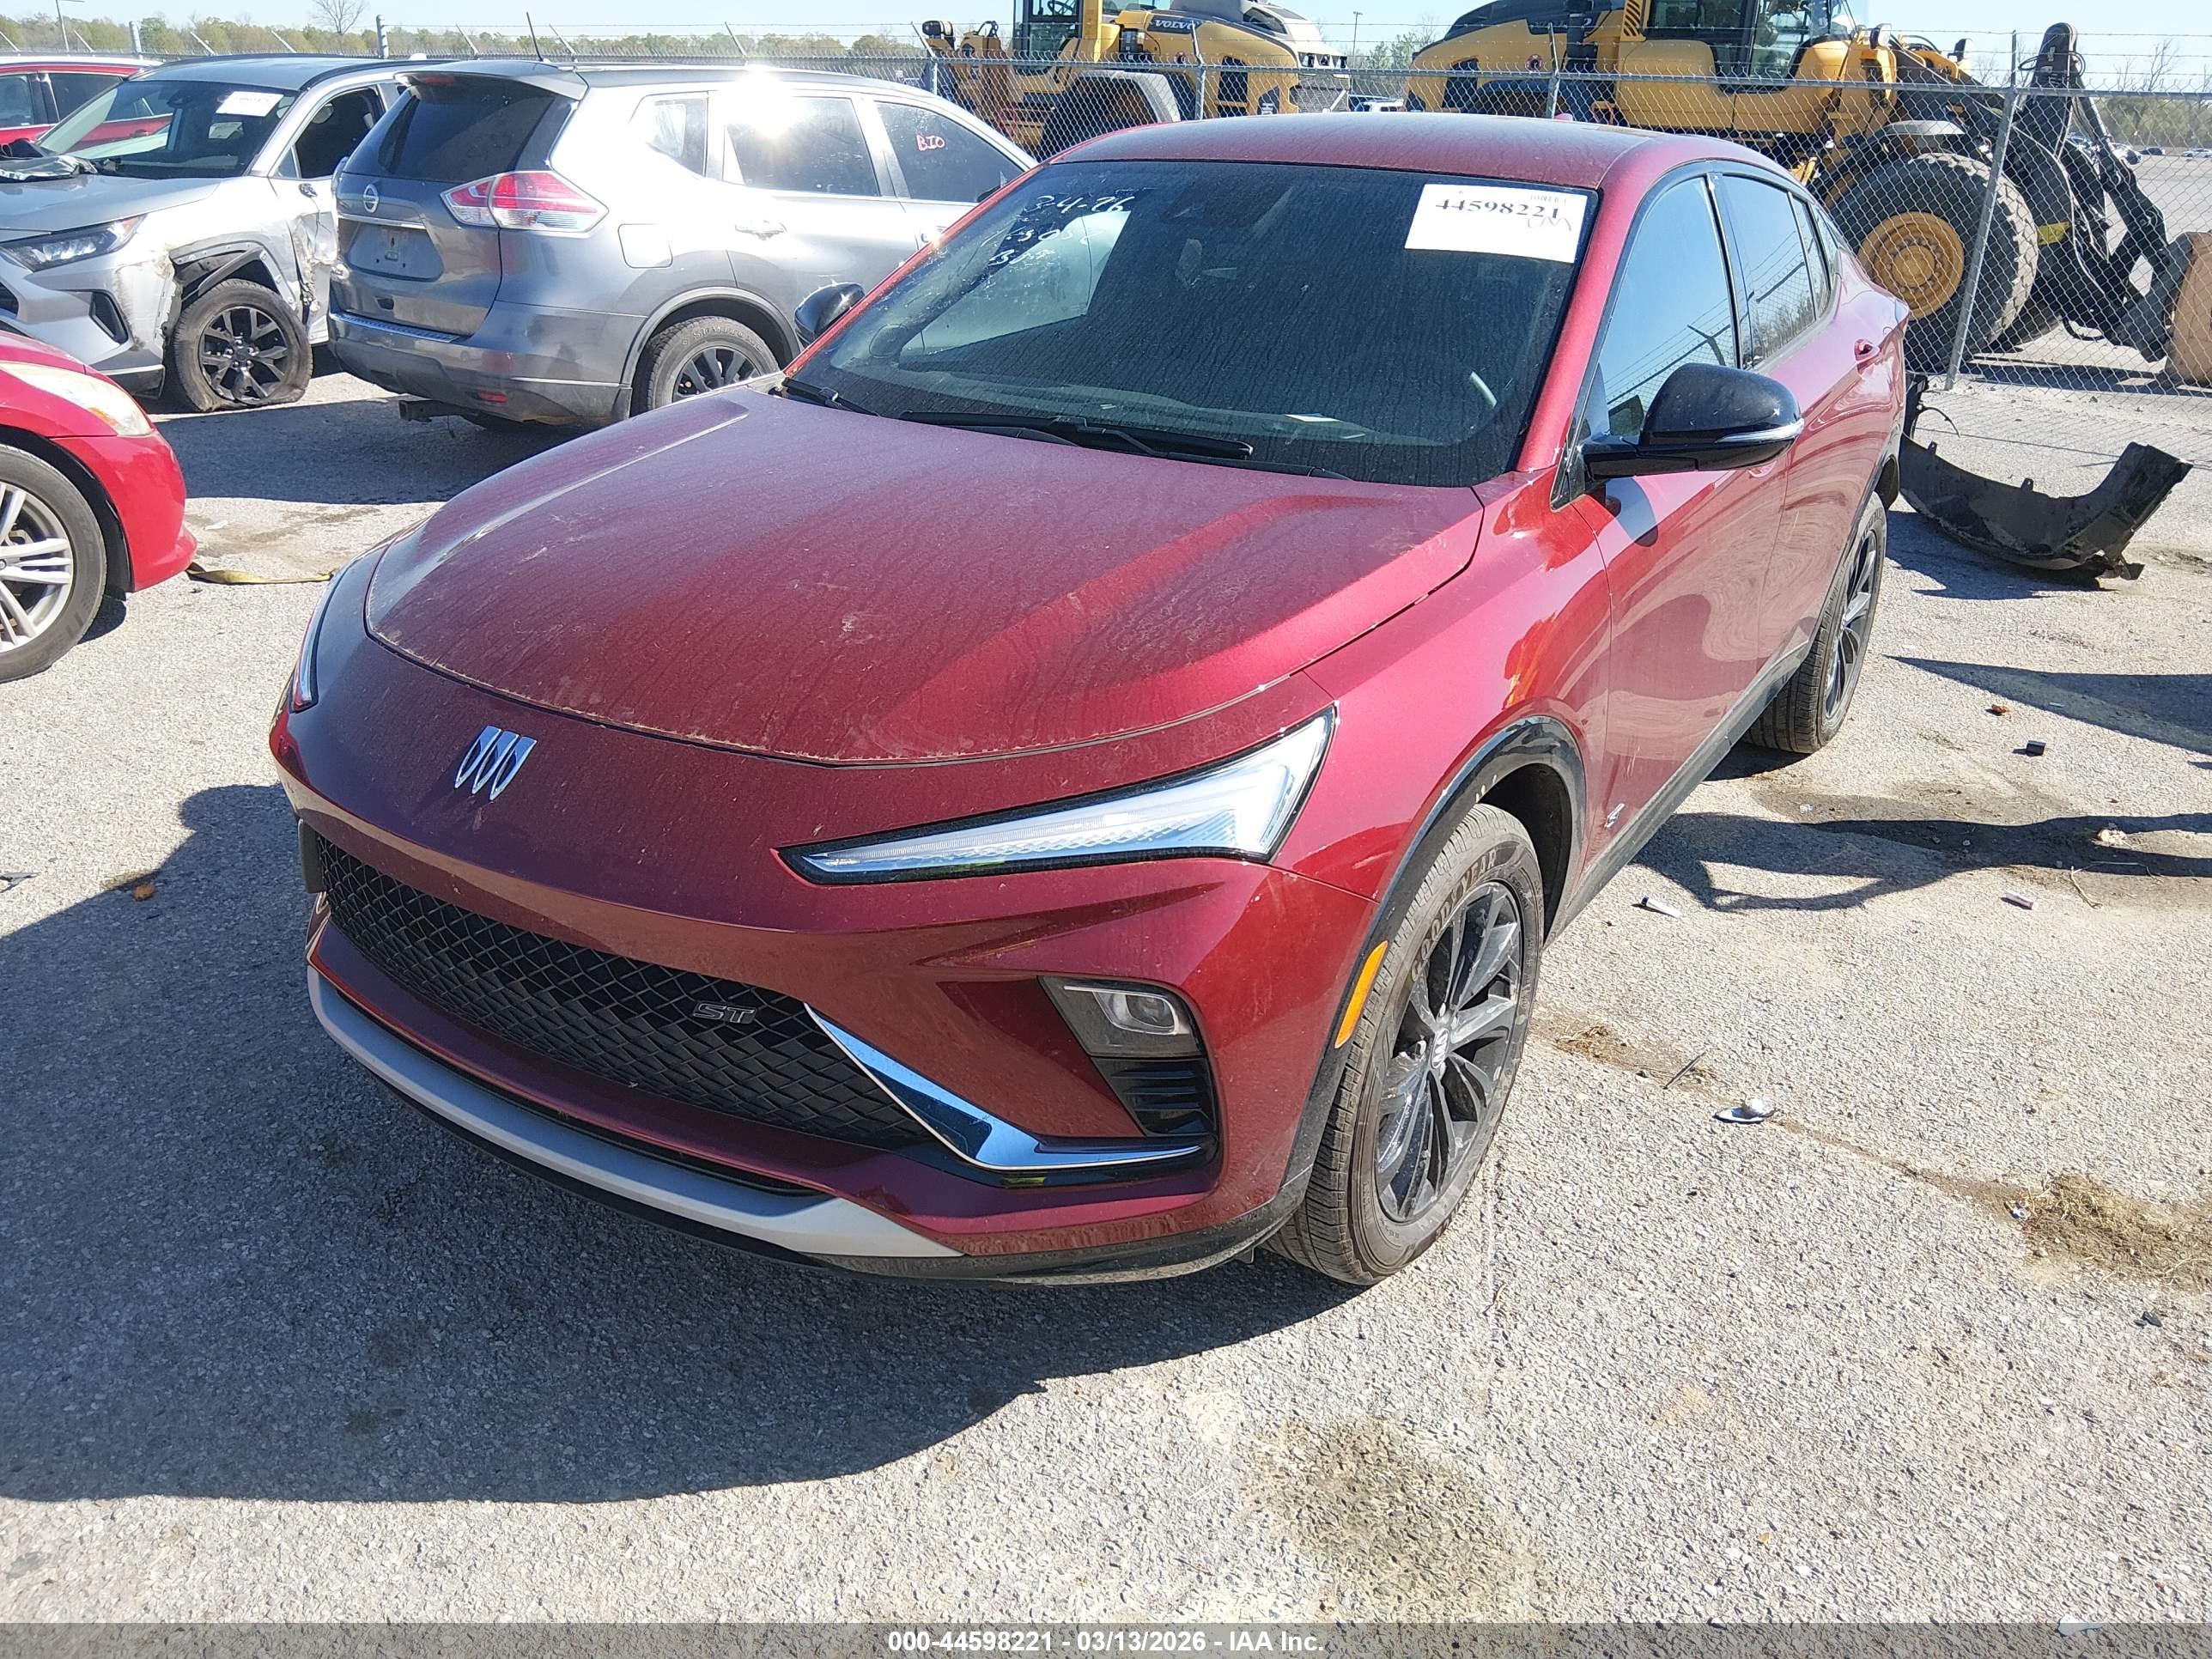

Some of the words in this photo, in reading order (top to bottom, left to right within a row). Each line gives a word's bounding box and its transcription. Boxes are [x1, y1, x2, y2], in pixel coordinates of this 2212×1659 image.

[1154, 19, 1195, 30] VOLVO
[916, 135, 945, 151] BIO
[1435, 198, 1559, 219] 44598221
[1411, 848, 1498, 982] GOODYEAR
[692, 1002, 756, 1024] ST
